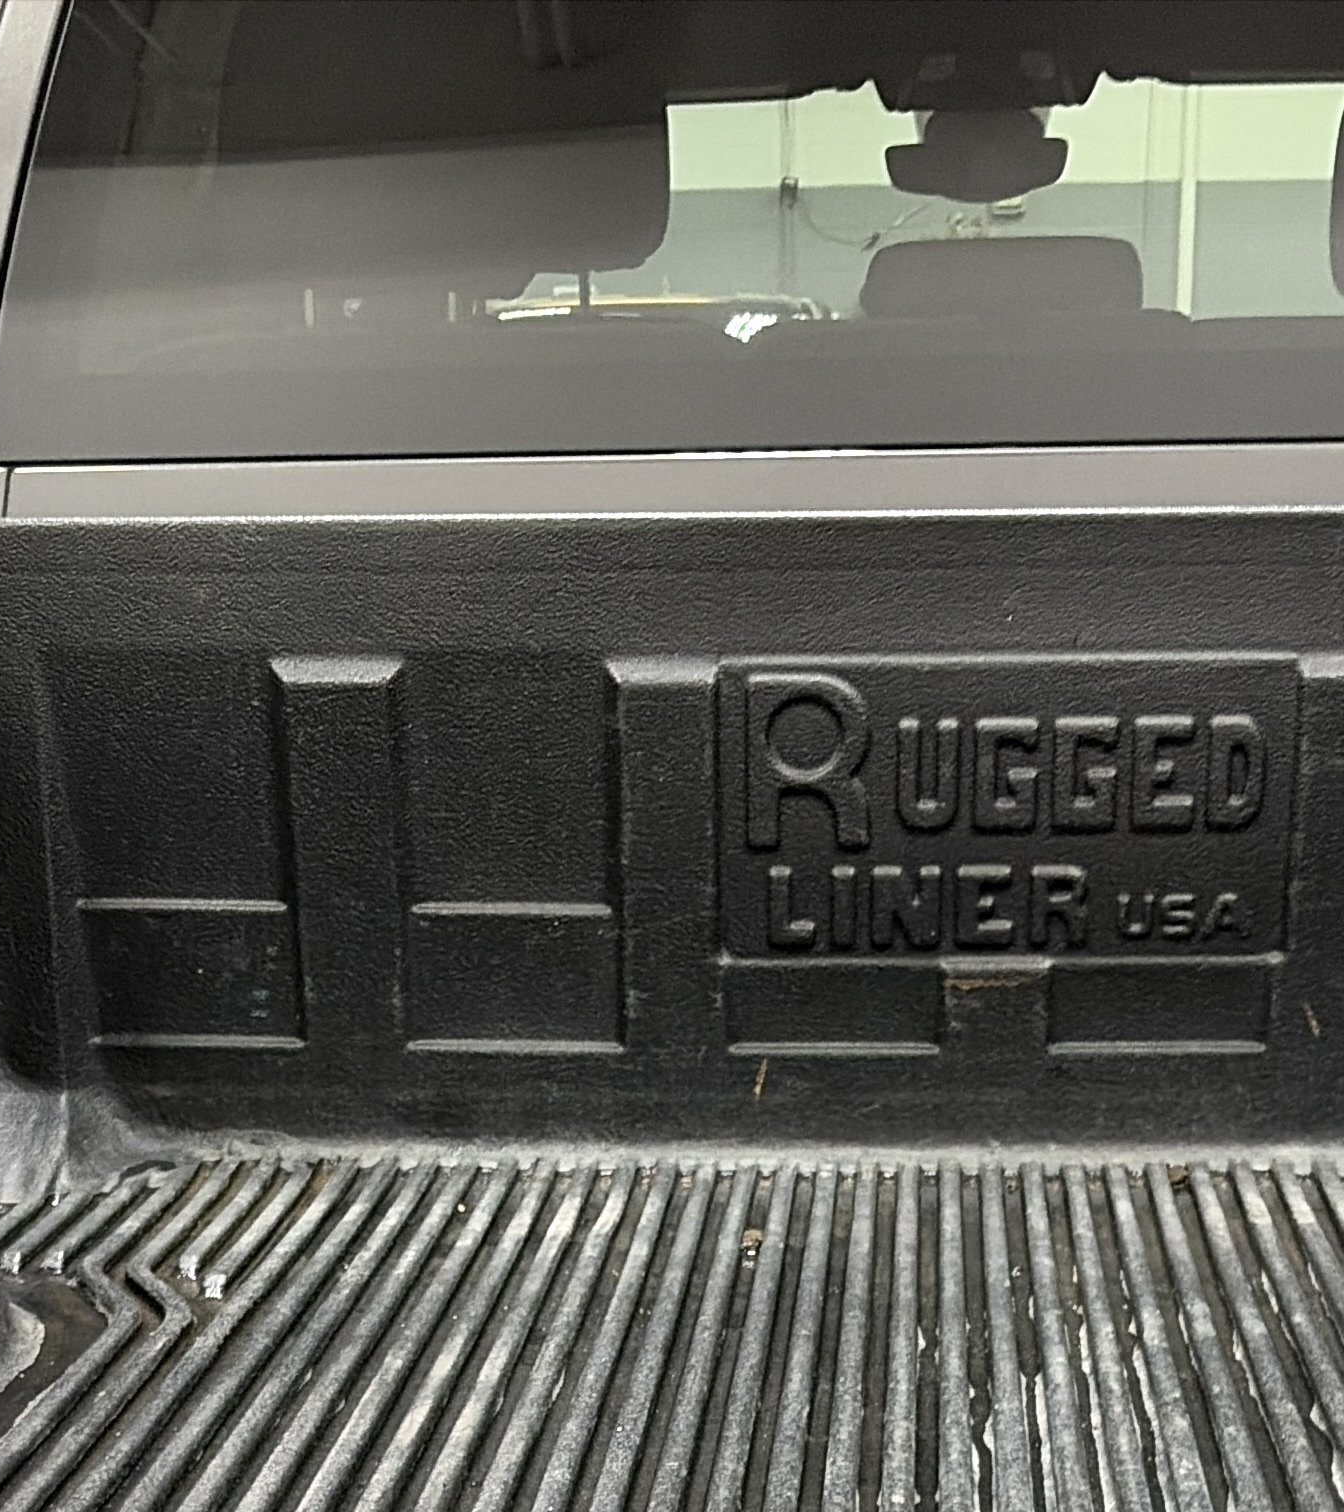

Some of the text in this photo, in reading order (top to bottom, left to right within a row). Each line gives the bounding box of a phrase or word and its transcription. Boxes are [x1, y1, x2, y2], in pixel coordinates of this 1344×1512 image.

[746, 672, 1264, 852] RUGGED
[766, 864, 1252, 949] LINER USA
